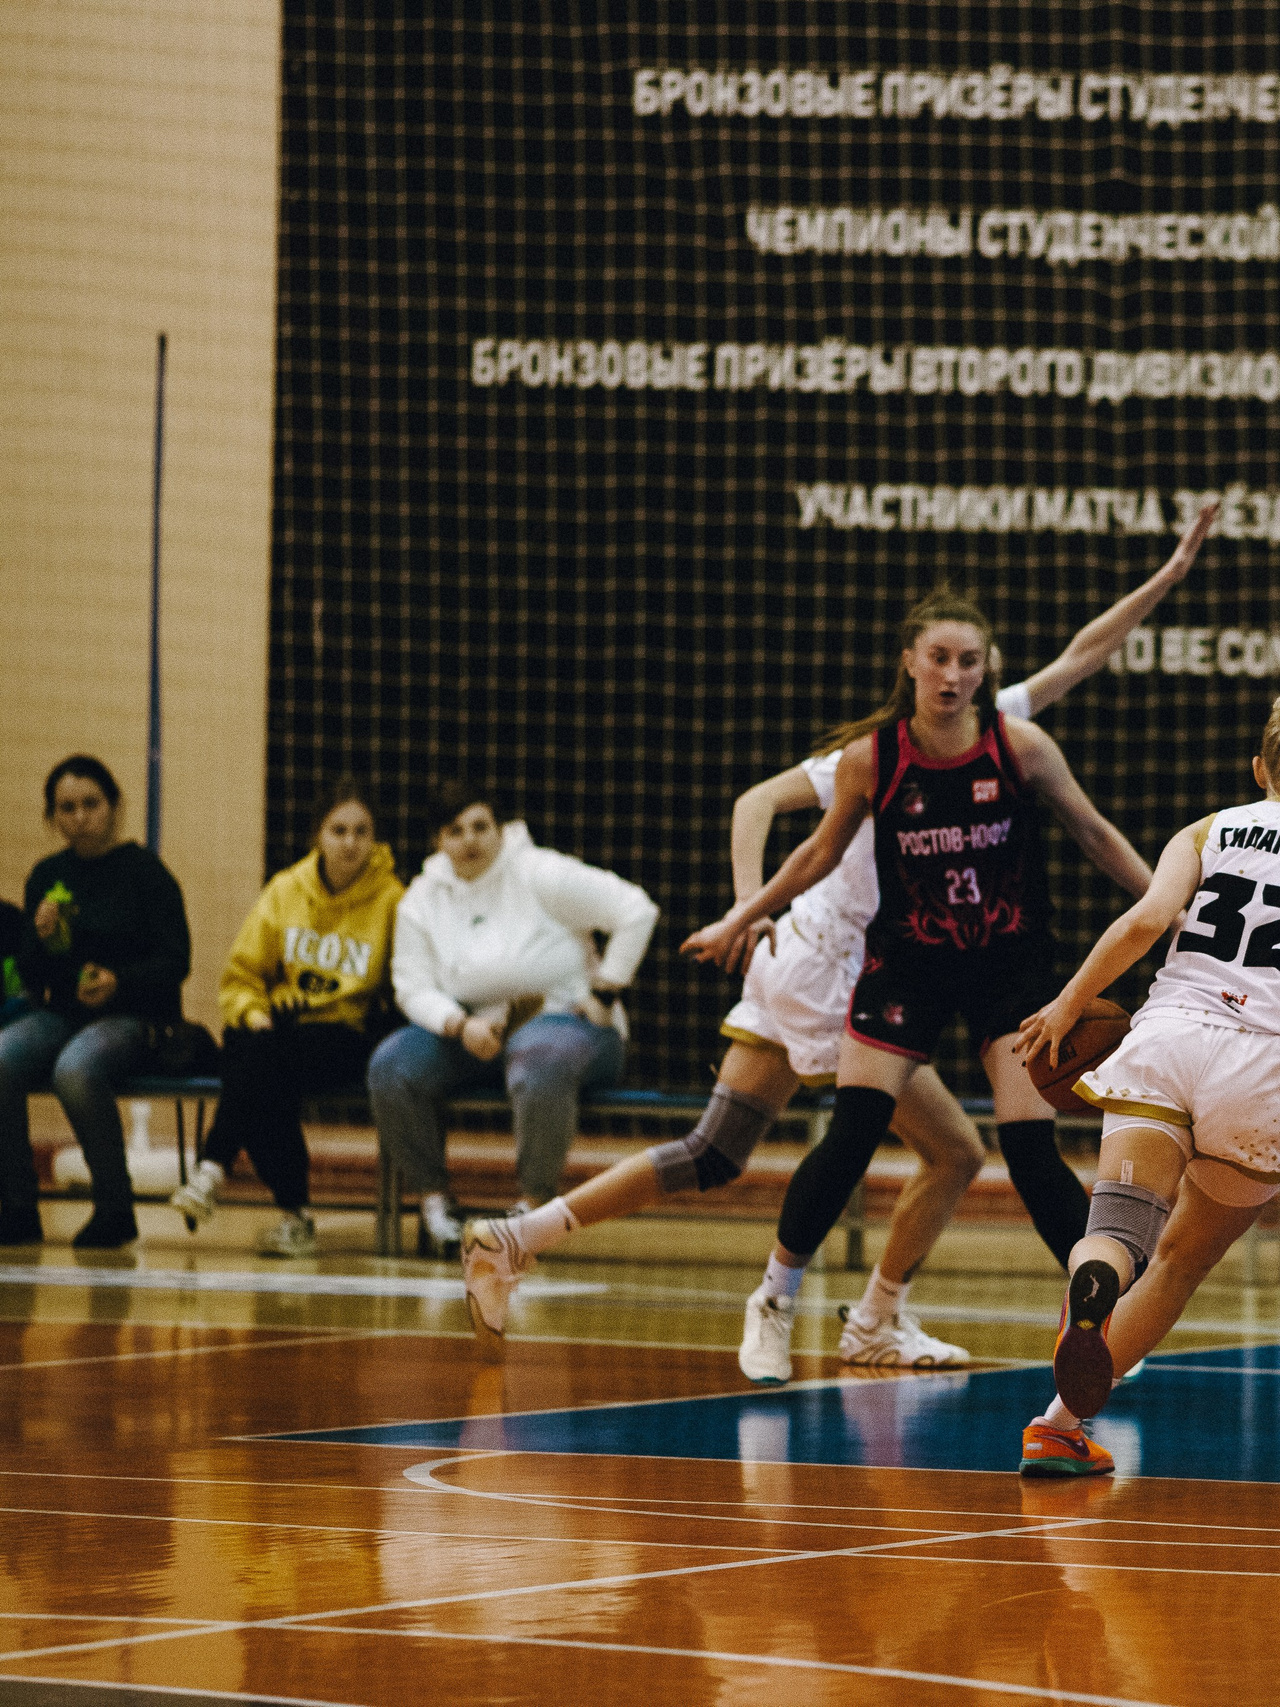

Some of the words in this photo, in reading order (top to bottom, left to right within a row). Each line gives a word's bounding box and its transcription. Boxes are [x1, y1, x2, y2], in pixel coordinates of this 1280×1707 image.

[634, 69, 876, 118] БРОНЗОВЫЕ
[880, 64, 1072, 121] ПРИЗЁРЫ
[745, 207, 972, 257] ЧЕМПИОНЫ
[471, 339, 707, 391] БРОНЗОВЫЕ
[713, 336, 908, 394] ПРИЗЁРЫ
[908, 345, 1085, 397] ВТОРОГО
[796, 482, 1029, 532] УЧАСТНИКИ
[1030, 487, 1165, 534] МАТЧА
[1160, 626, 1215, 676] BE
[944, 867, 981, 905] 23
[284, 926, 371, 978] ICON
